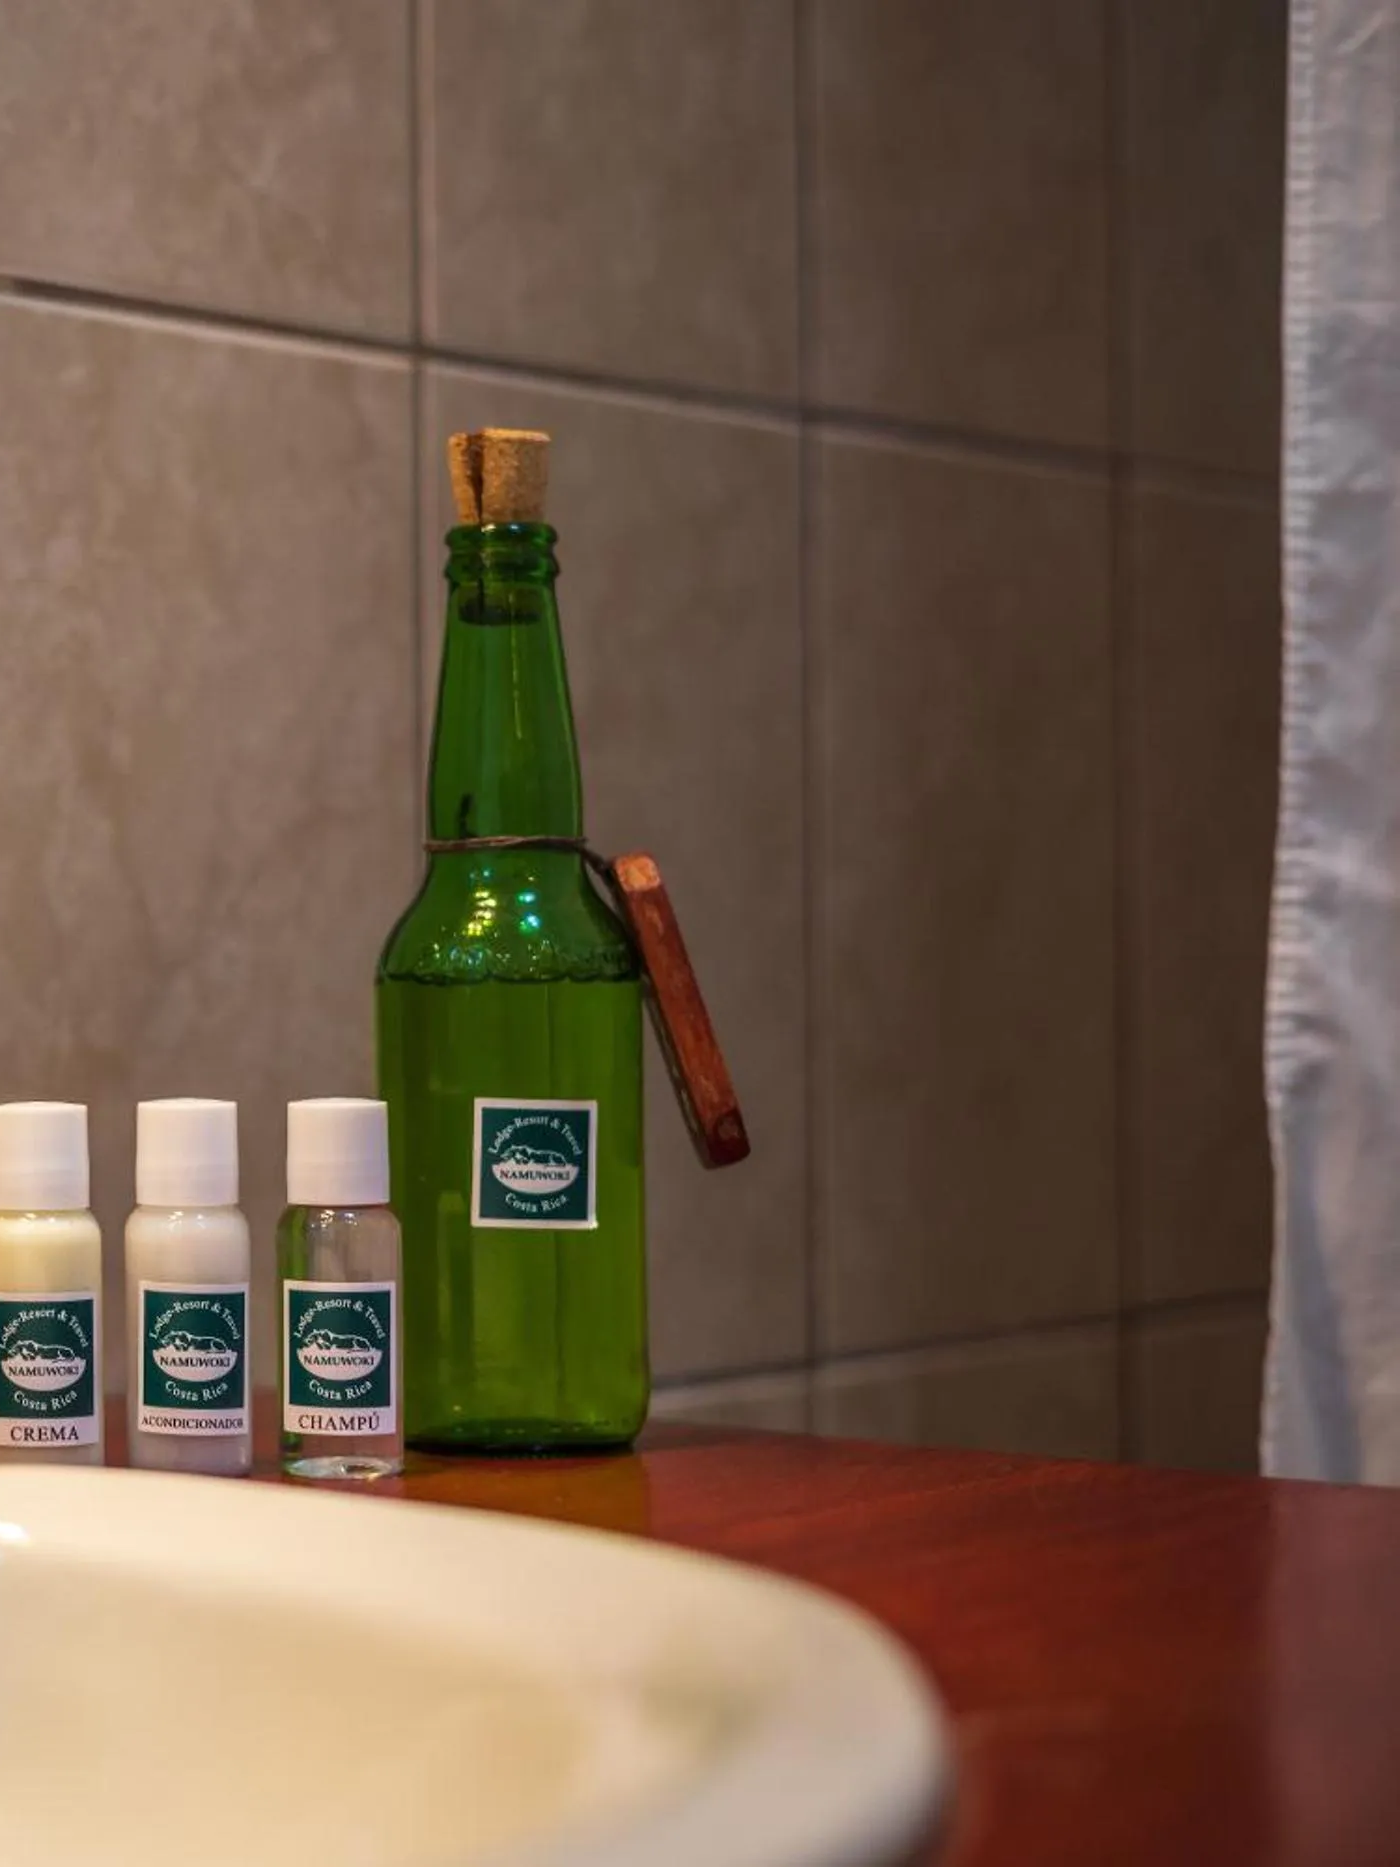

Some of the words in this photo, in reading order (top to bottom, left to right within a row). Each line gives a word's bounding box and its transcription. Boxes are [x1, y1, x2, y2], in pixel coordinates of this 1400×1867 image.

[505, 1192, 538, 1213] Costa
[541, 1194, 568, 1212] Rica
[160, 1355, 232, 1368] NAMUWOKI
[304, 1355, 375, 1366] NAMUWOKI
[8, 1365, 79, 1377] NAMUWOKI
[165, 1380, 199, 1401] Costa
[202, 1382, 228, 1401] Rica
[309, 1379, 342, 1400] Costa
[346, 1380, 373, 1400] Rica
[13, 1390, 48, 1411] Costa
[52, 1390, 78, 1410] Rica
[298, 1412, 381, 1431] CHAMPÚ
[10, 1426, 80, 1442] CREMA
